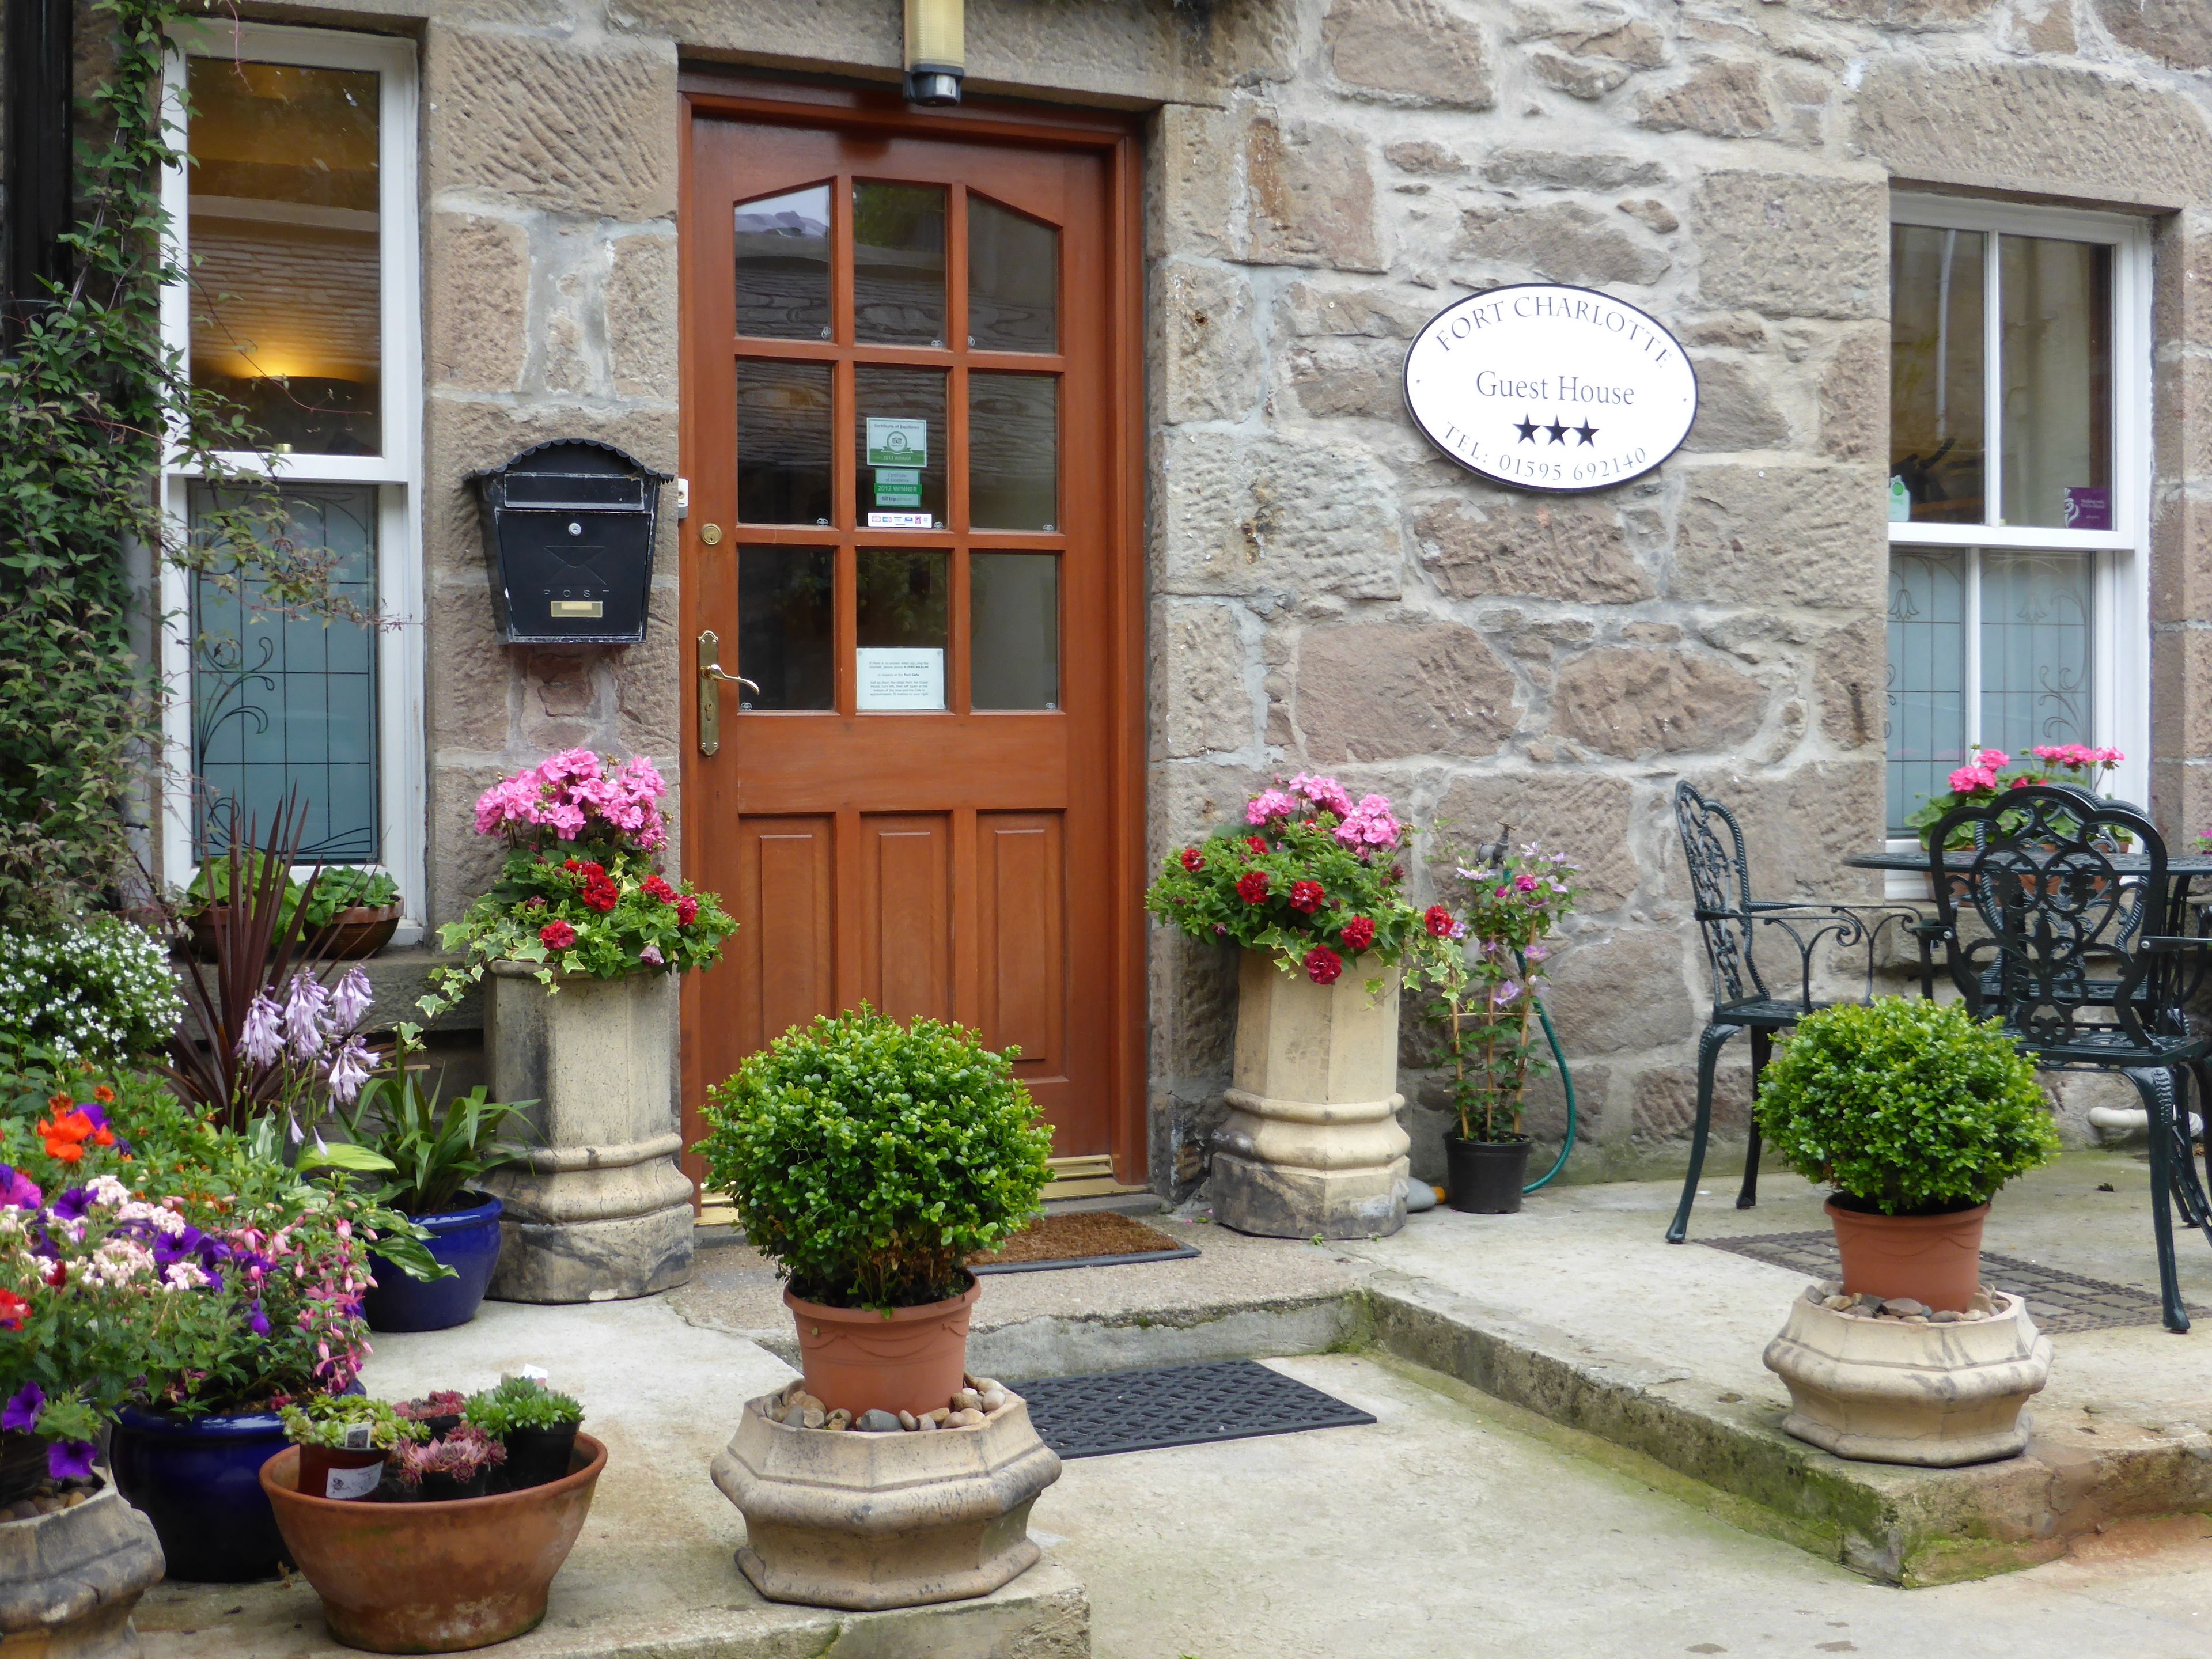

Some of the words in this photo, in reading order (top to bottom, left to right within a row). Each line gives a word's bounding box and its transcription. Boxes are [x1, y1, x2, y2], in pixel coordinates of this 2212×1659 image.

[1435, 301, 1505, 352] FORT
[1513, 296, 1673, 369] CHARLOTTE
[1476, 370, 1548, 400] Guest
[1558, 376, 1635, 406] House
[1444, 421, 1488, 463] TEL:
[1499, 454, 1562, 480] 01595
[1573, 447, 1646, 480] 692140
